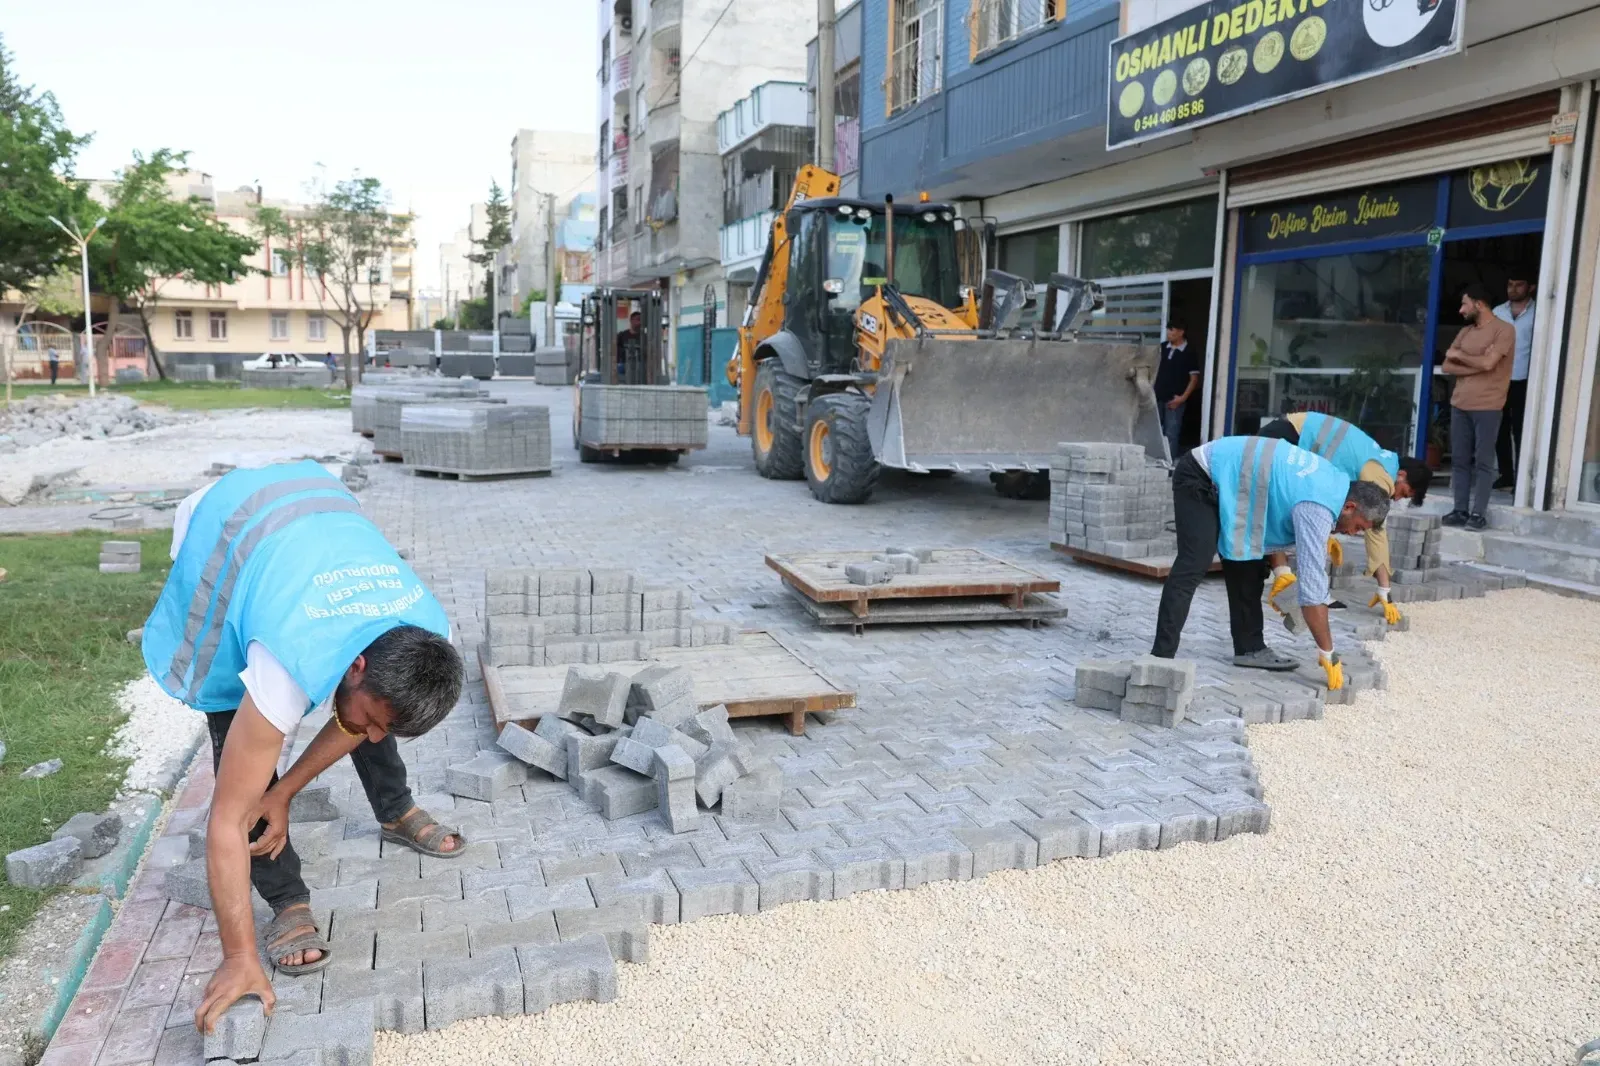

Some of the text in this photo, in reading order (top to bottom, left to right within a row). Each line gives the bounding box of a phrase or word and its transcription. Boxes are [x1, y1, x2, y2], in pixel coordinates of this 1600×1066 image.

[1116, 20, 1208, 82] OSMANLI
[1134, 98, 1204, 132] 0 544 460 85 86
[1267, 212, 1308, 239] Define
[1310, 204, 1348, 233] Bizim
[861, 312, 878, 333] JCB
[376, 578, 403, 590] FEN
